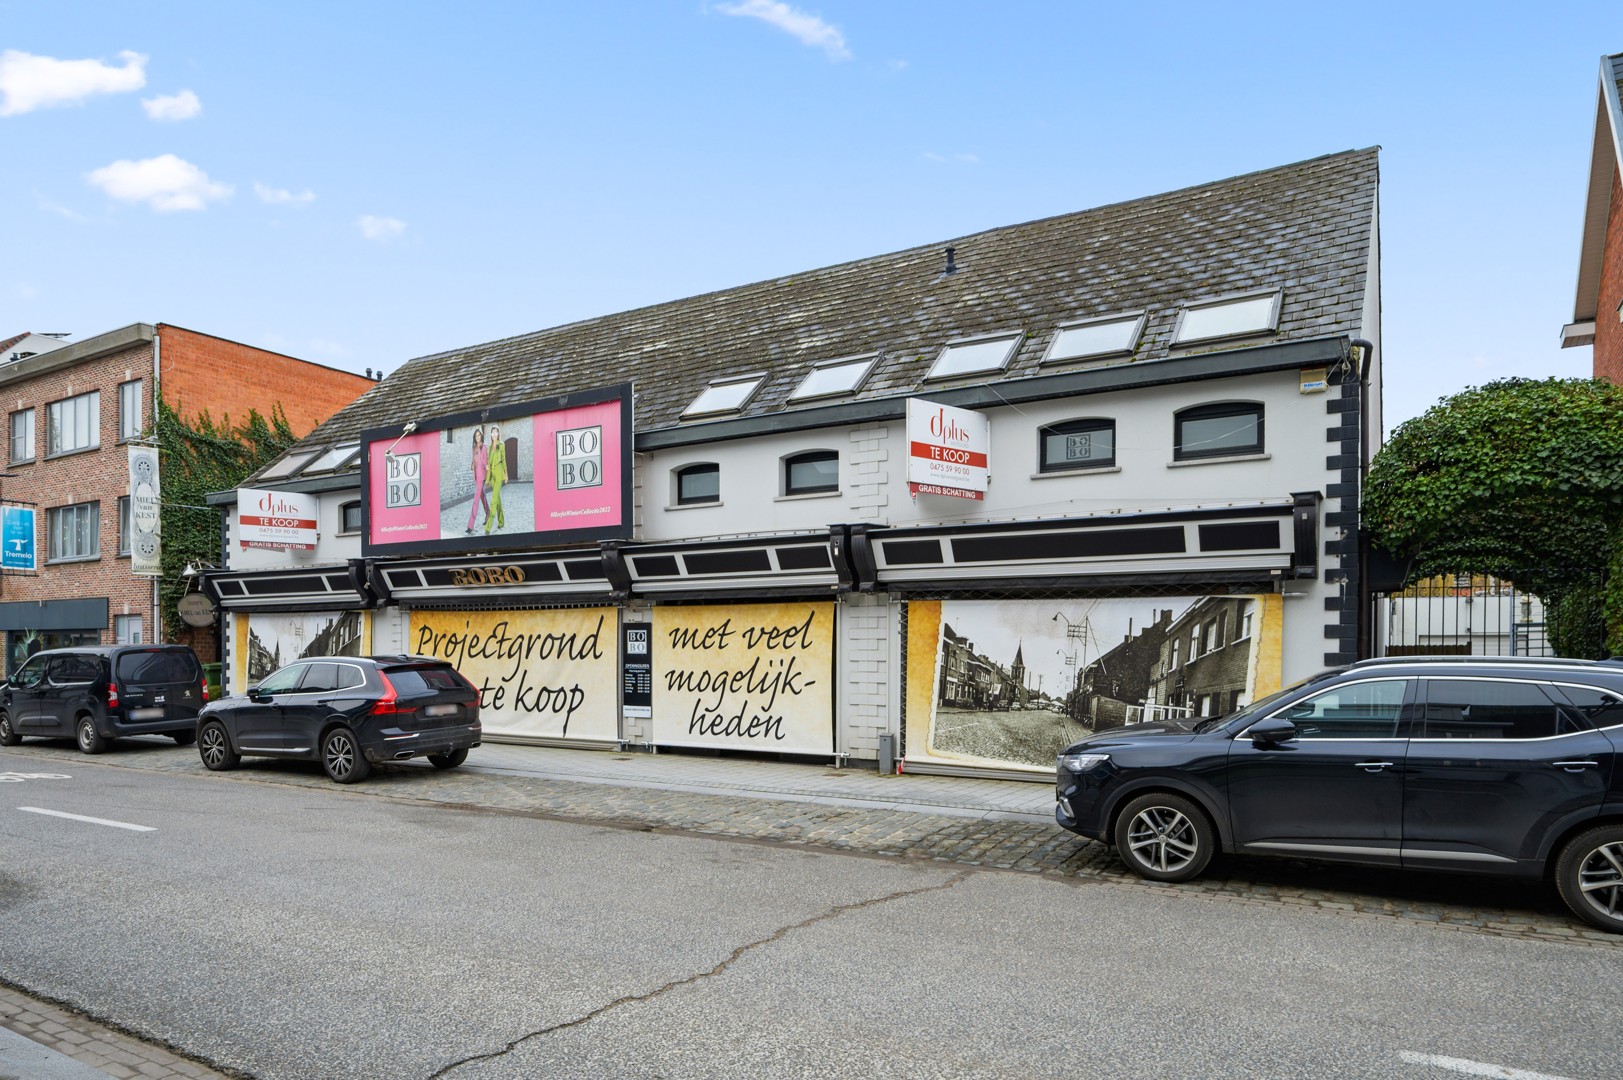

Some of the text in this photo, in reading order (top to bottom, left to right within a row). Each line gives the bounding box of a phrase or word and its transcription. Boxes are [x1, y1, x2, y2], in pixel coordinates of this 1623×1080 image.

[930, 407, 970, 445] dplus
[560, 430, 598, 457] BO
[1069, 437, 1088, 447] BO
[1069, 448, 1088, 457] BO
[930, 446, 970, 463] TE KOOP
[561, 459, 598, 486] BO
[929, 462, 945, 472] 0475
[945, 465, 953, 473] 59
[954, 467, 962, 475] 90
[390, 482, 418, 504] BO
[918, 484, 976, 499] GRATIS SCHATTING
[258, 493, 299, 516] dplus
[259, 517, 299, 528] TE KOOP
[4, 550, 33, 559] Tremelo
[272, 542, 307, 550] SCHATTING
[448, 565, 526, 587] BOBO
[629, 632, 645, 641] BO
[668, 610, 815, 650] met veel
[415, 614, 605, 683] Projectgrond
[629, 643, 645, 652] BO
[664, 655, 816, 713] mogelijk-
[479, 669, 586, 738] te koop
[688, 697, 786, 741] heden
